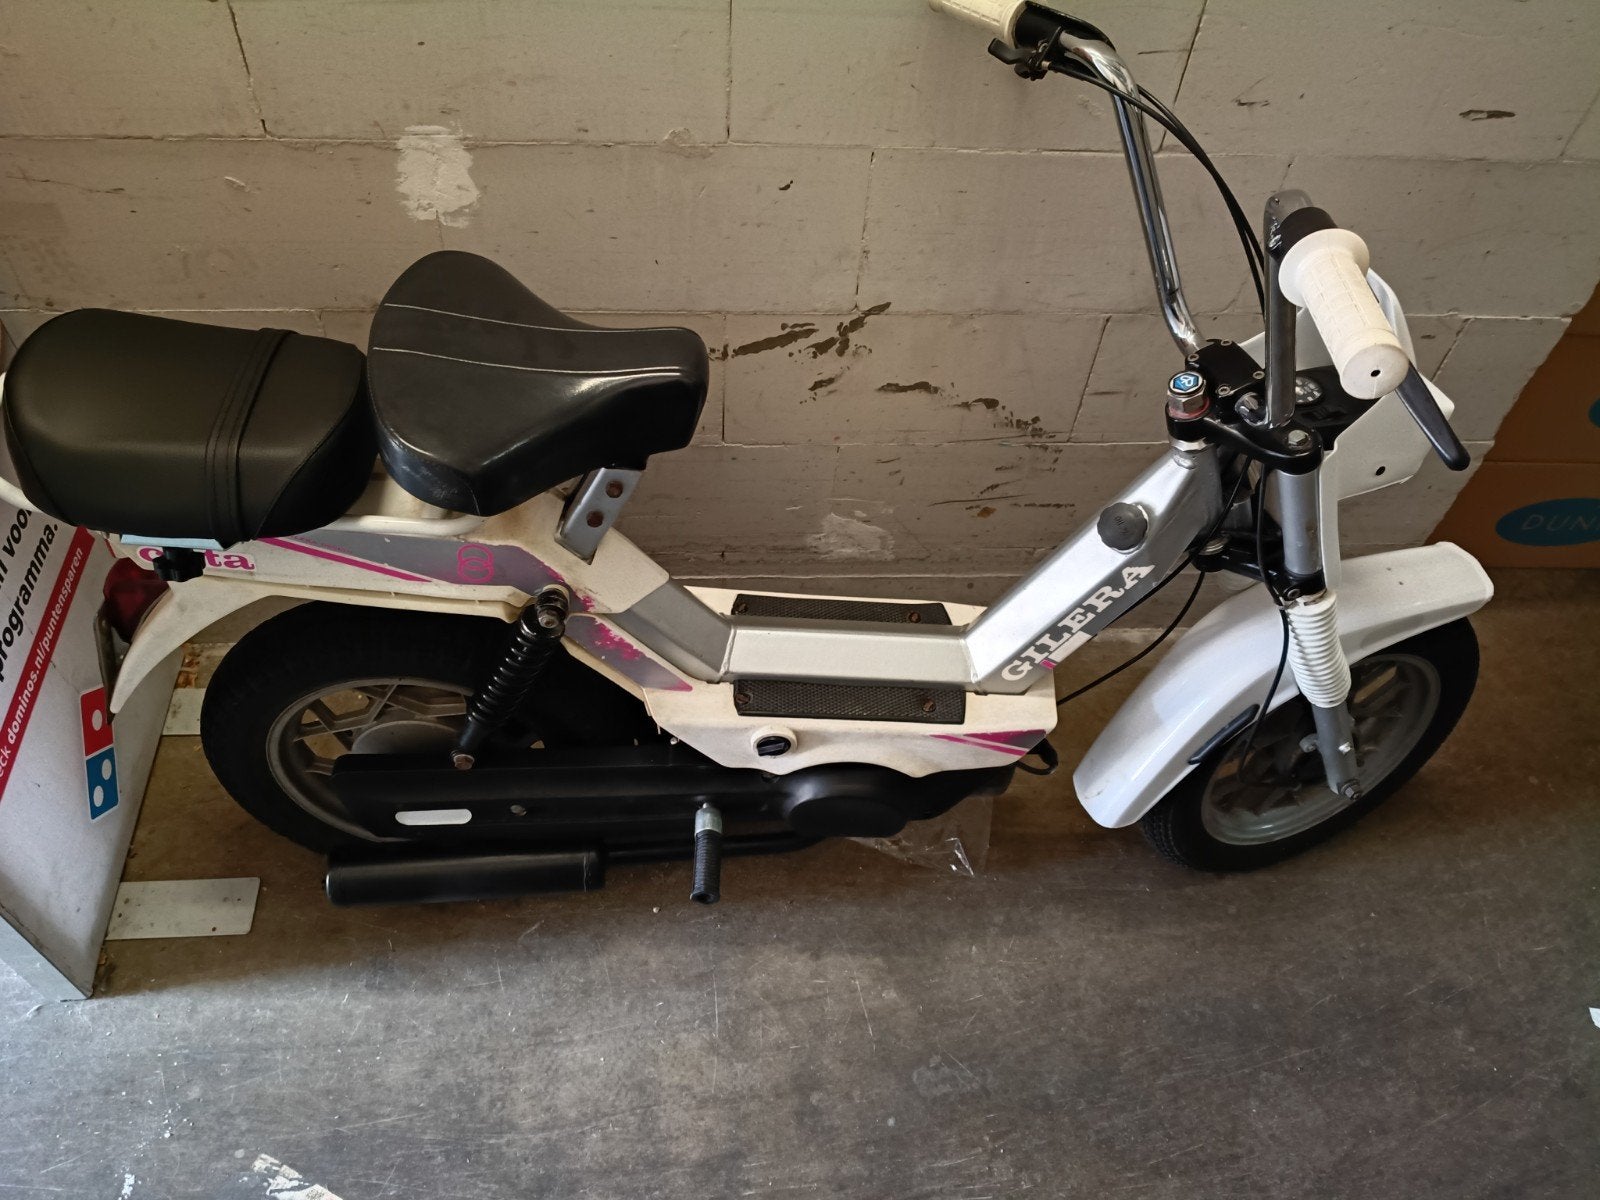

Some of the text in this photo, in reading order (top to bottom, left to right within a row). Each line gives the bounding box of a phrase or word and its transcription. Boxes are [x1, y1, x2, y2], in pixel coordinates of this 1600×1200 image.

[2, 508, 32, 558] voo
[1520, 513, 1600, 532] DUN
[139, 547, 255, 570] Cta
[7, 547, 83, 745] dominos.nl/puntensparen
[1001, 564, 1155, 681] GILERA
